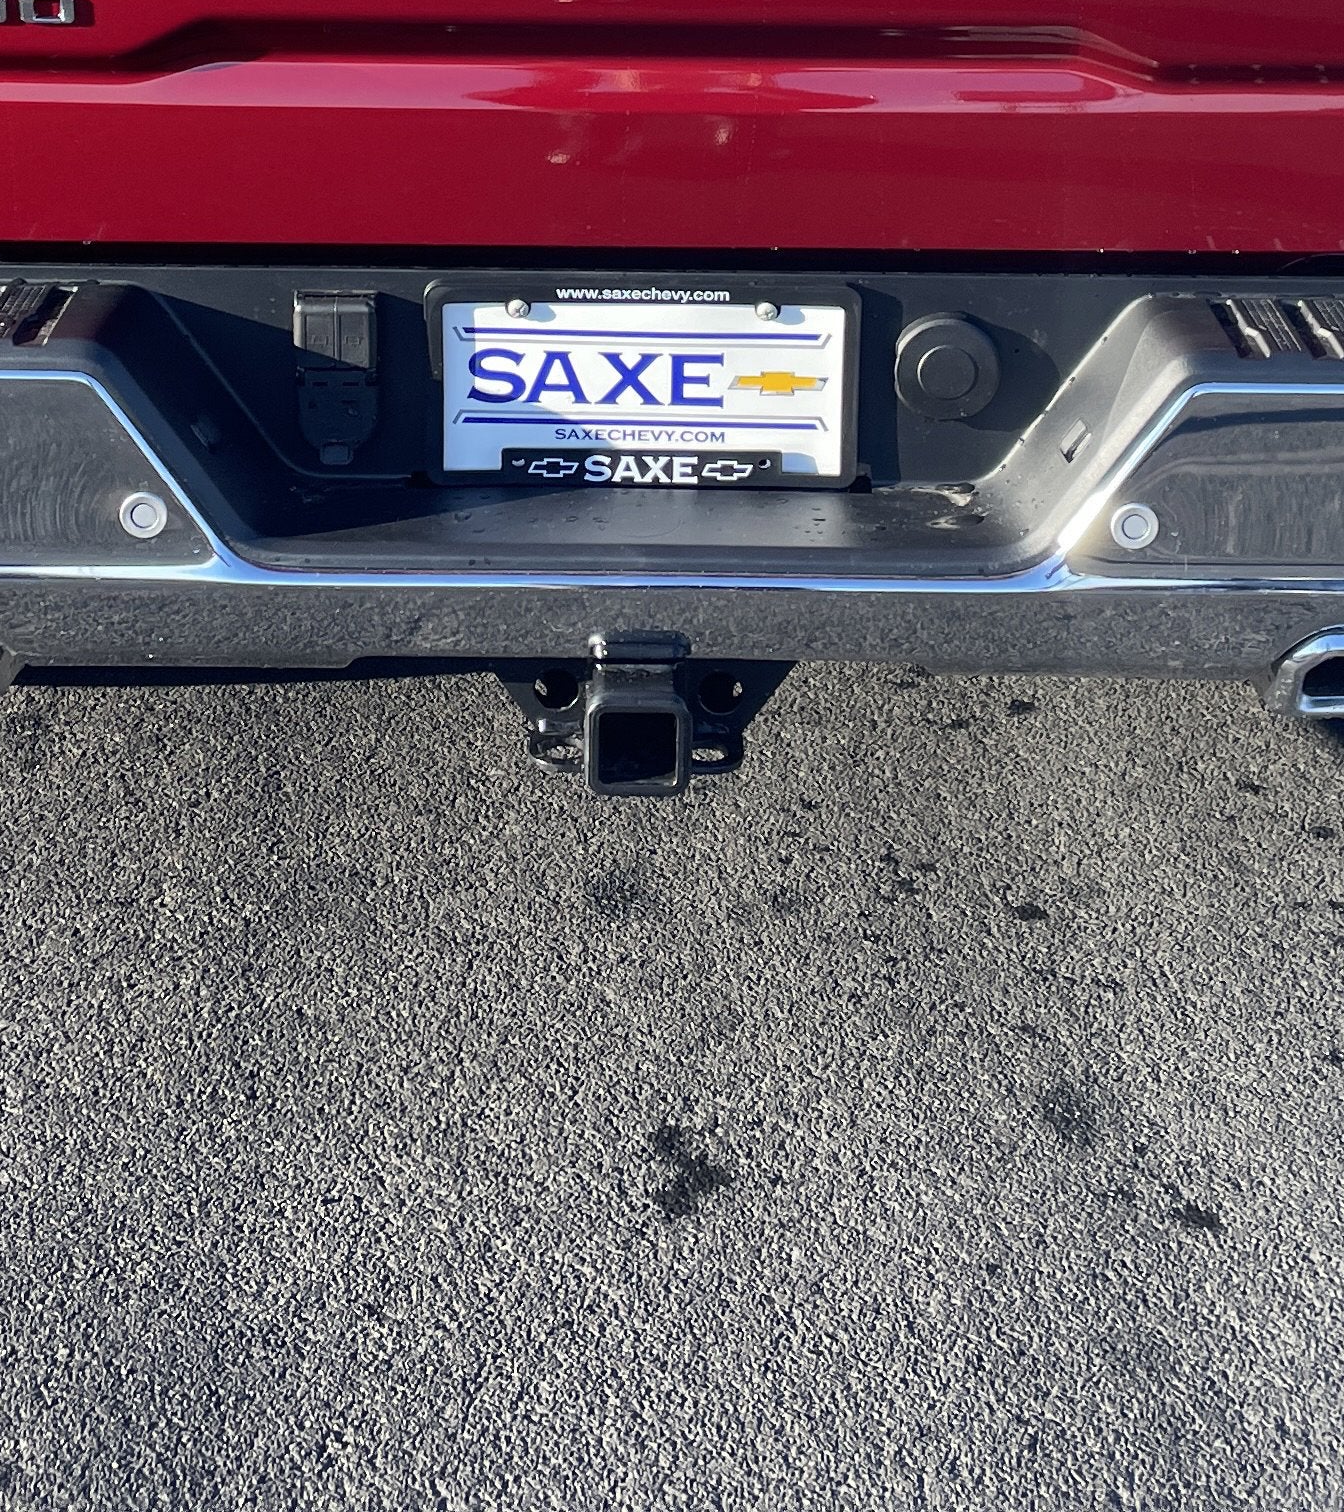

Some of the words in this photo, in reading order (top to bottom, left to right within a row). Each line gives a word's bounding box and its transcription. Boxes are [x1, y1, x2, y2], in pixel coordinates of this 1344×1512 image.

[555, 288, 730, 304] www.saxechevy.com
[466, 347, 725, 409] SAXE
[554, 427, 726, 444] SAXECHEVY.COM
[583, 454, 699, 485] SAXE
